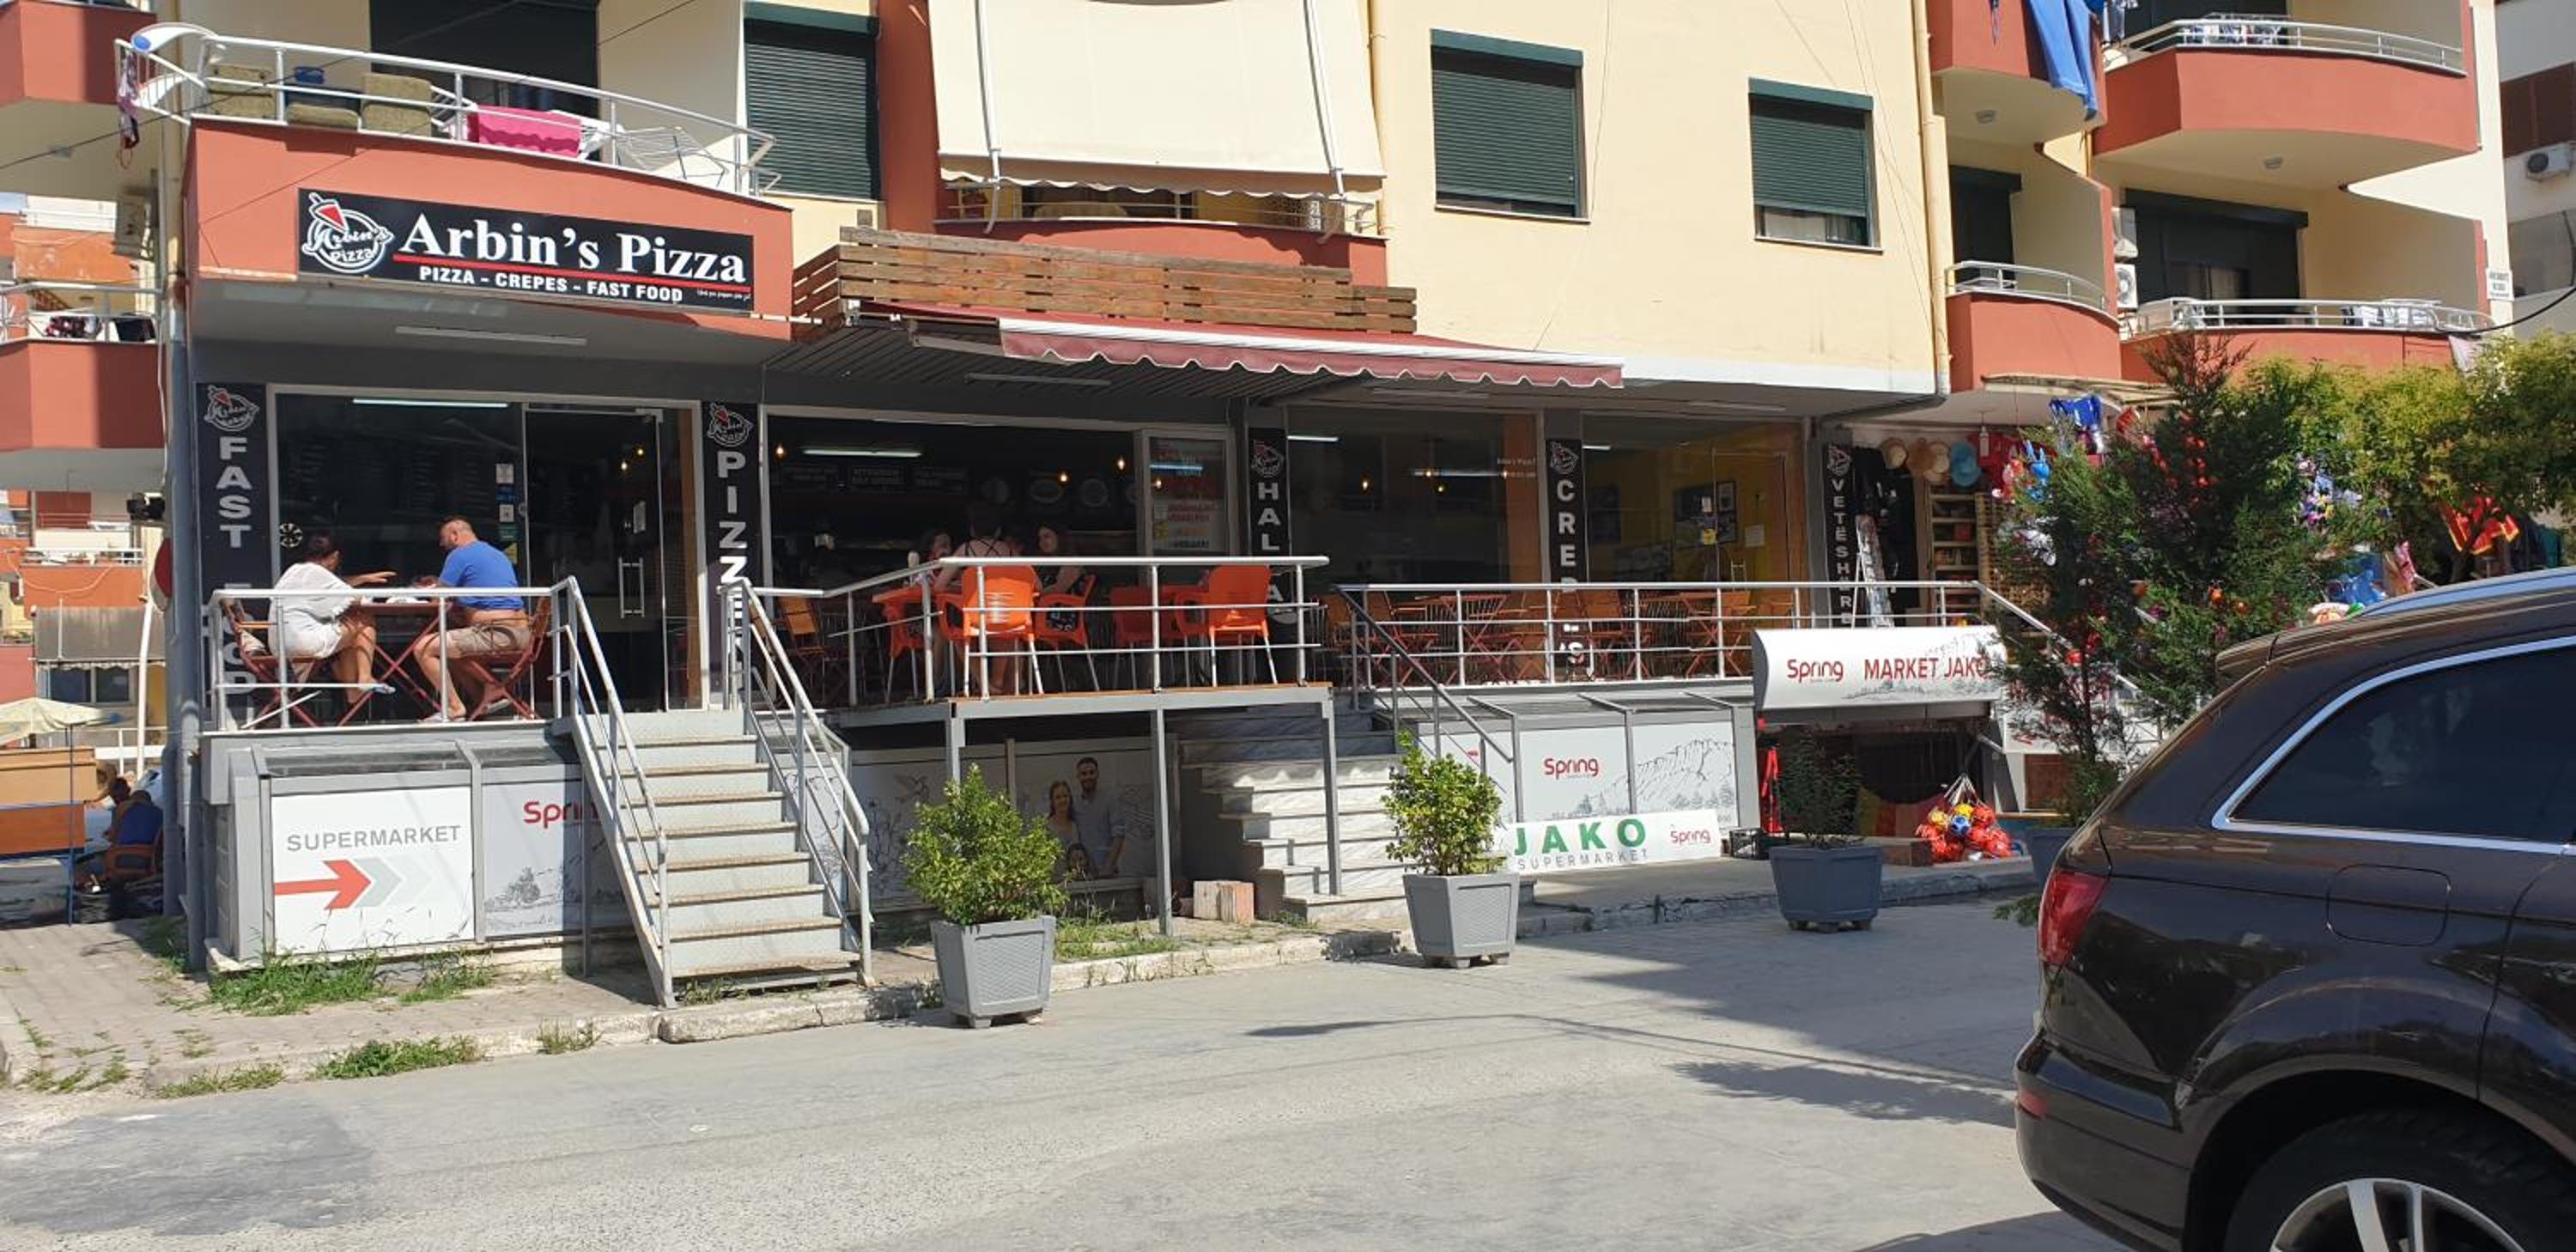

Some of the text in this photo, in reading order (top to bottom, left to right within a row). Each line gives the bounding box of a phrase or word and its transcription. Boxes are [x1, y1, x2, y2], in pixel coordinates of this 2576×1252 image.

[398, 213, 746, 283] Arbin's Pizza
[419, 265, 475, 284] PIZZA
[495, 272, 568, 292] CREPES
[586, 281, 630, 298] FAST
[635, 285, 683, 302] FOOD
[216, 436, 252, 549] FAST
[1787, 656, 1991, 684] Spring MARKET JAKO
[1544, 757, 1600, 780] Spring
[287, 824, 462, 851] SUPERMARKET
[1513, 817, 1710, 856] JAKO Spring
[1516, 848, 1648, 871] SUPERMARKET
